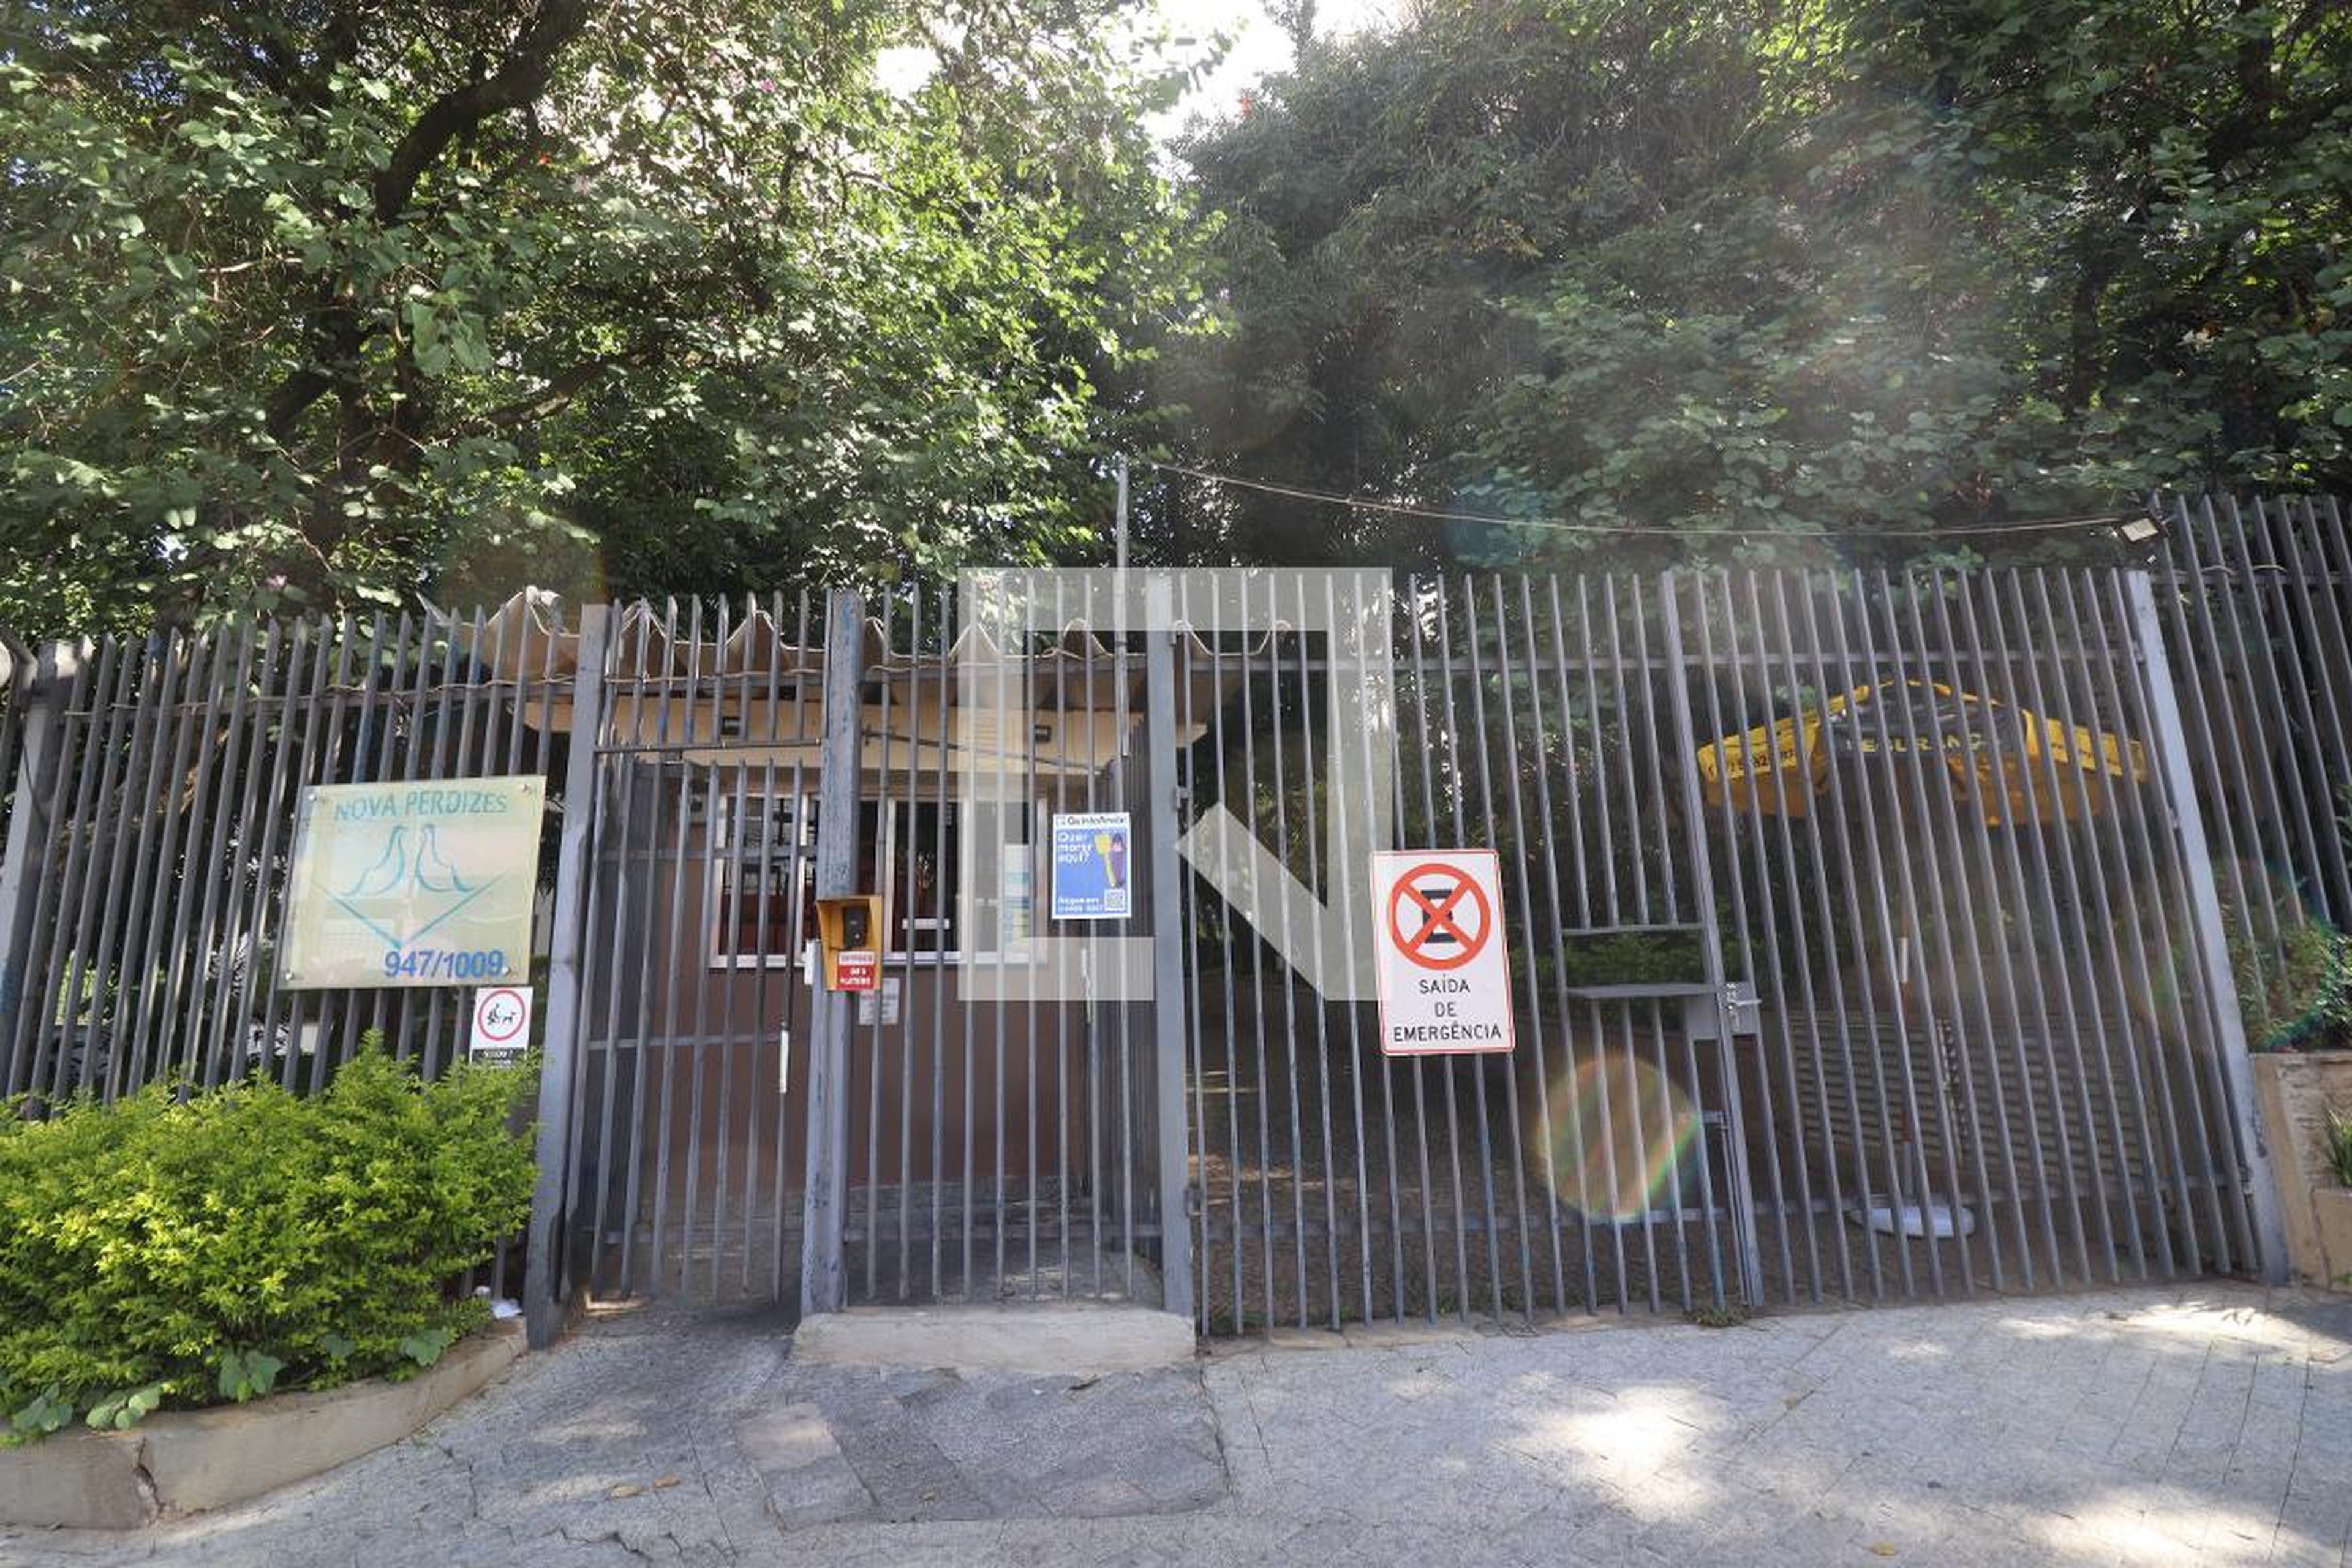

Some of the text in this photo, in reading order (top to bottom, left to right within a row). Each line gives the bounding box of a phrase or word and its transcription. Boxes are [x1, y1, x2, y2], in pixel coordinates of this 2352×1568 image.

[334, 791, 507, 821] NOVA PERDIZES
[385, 949, 503, 979] 947/1009
[1419, 973, 1471, 993] SAÍDA
[1435, 1001, 1457, 1017] DE
[1393, 1021, 1502, 1041] EMERGÊNCIA
